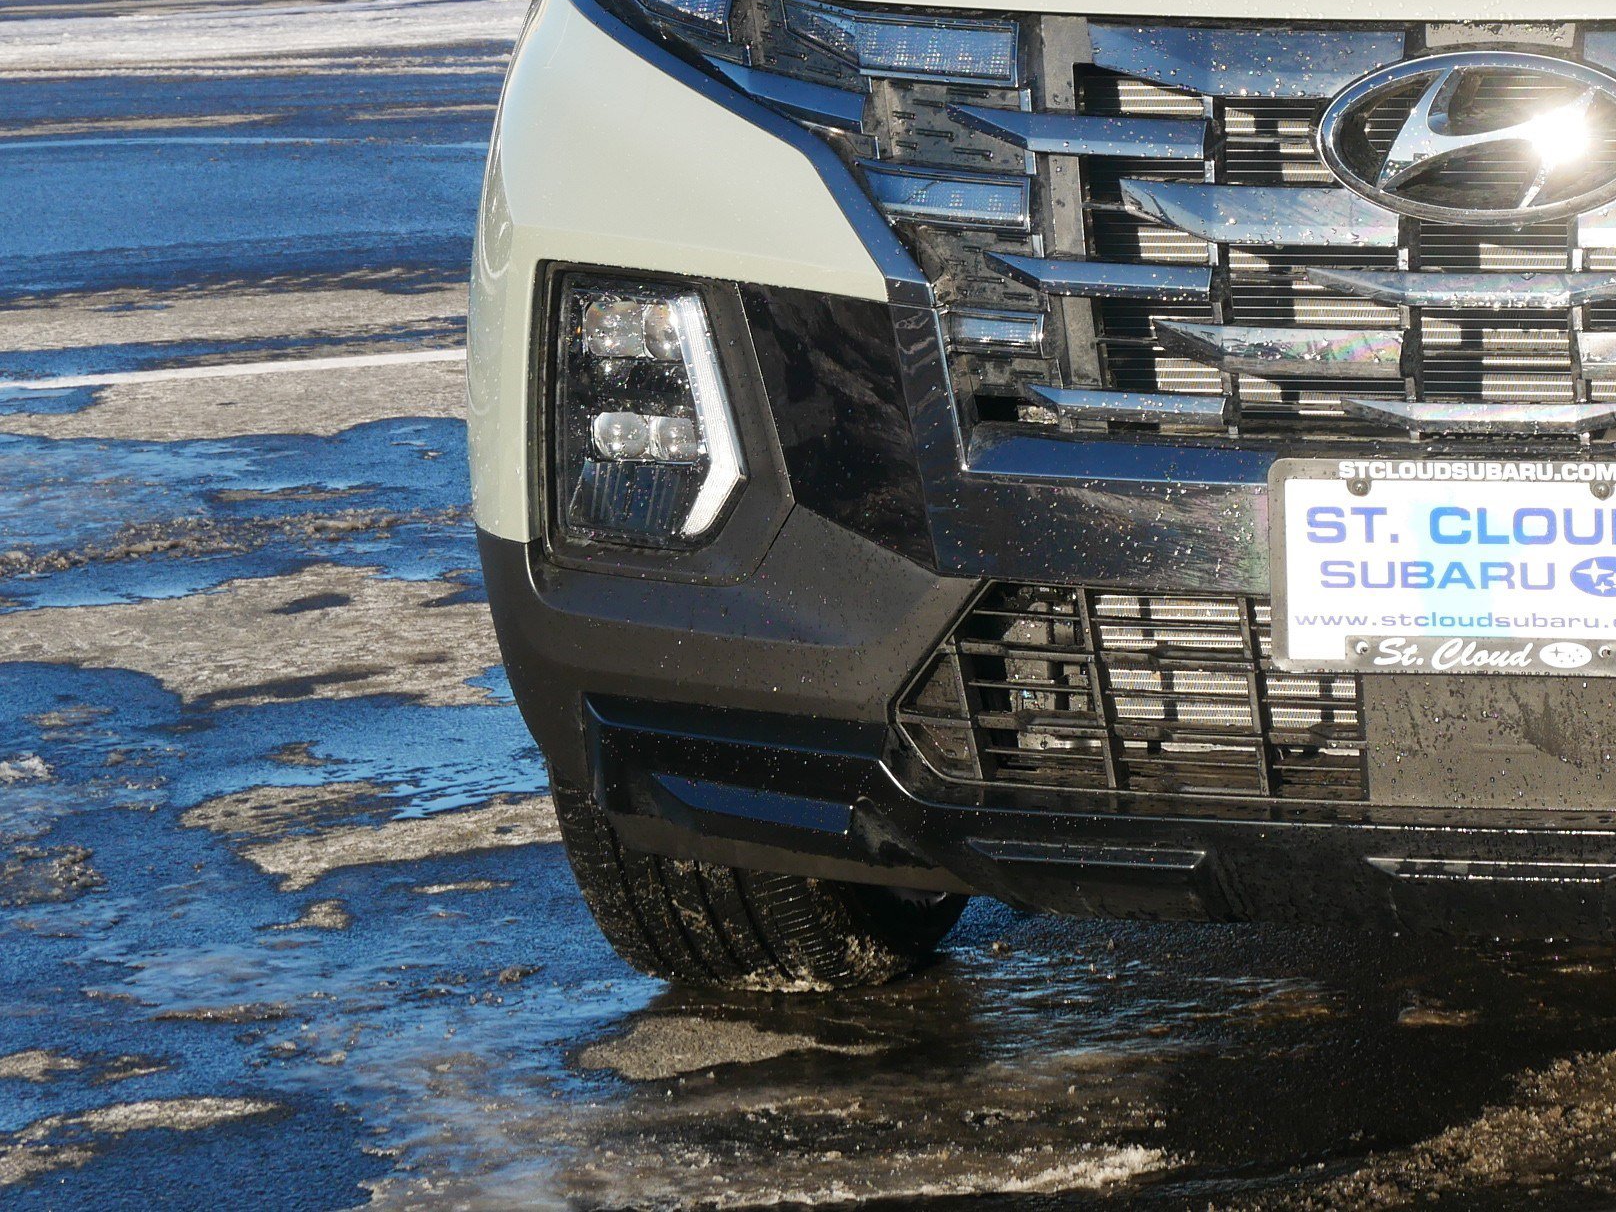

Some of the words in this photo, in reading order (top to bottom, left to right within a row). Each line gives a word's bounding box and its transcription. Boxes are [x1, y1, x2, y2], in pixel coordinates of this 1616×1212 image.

[1306, 506, 1399, 544] ST.
[1319, 560, 1556, 590] SUBARU
[1373, 637, 1424, 667] St.
[1431, 639, 1533, 669] Cloud
